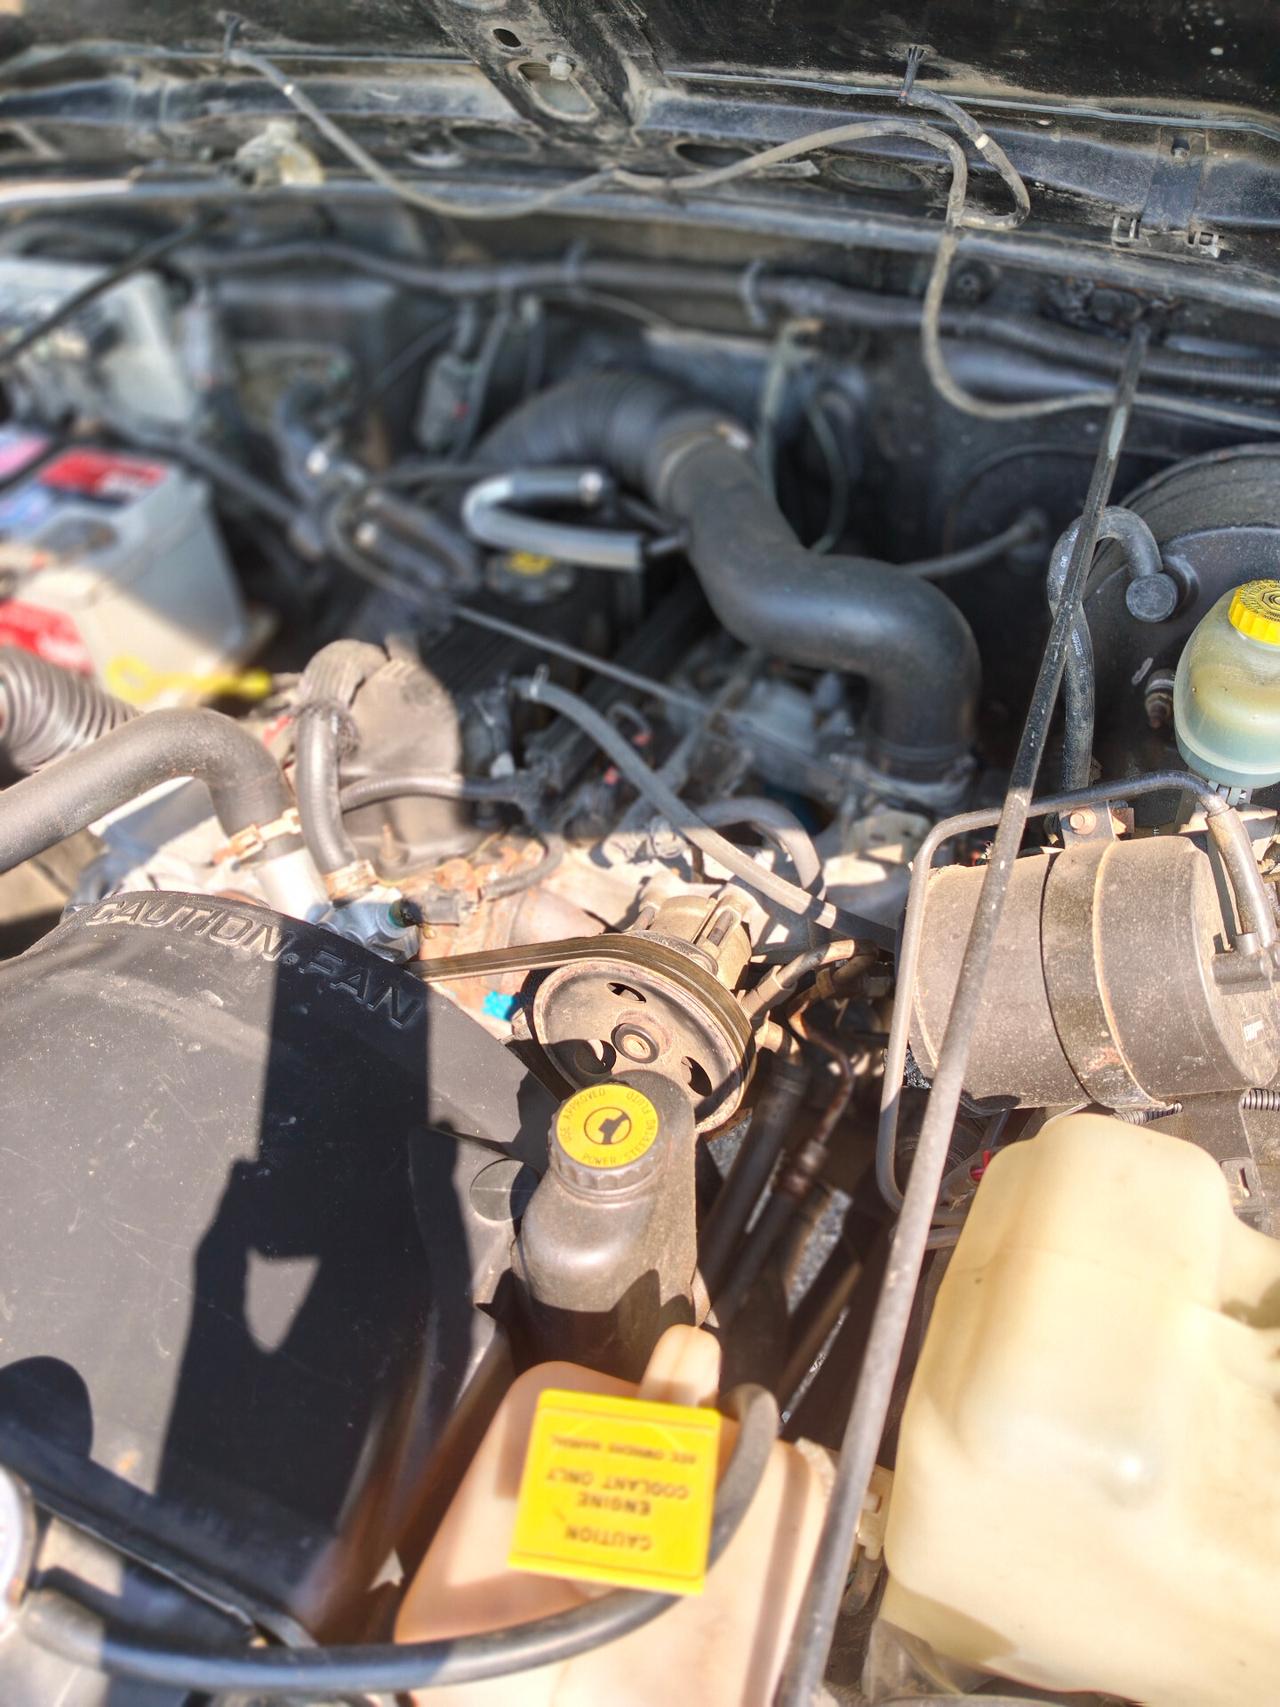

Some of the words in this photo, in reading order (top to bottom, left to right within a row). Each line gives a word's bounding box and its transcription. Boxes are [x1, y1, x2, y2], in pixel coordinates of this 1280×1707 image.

[87, 900, 293, 961] CAUTION
[299, 950, 424, 1029] FAN
[563, 1088, 605, 1119] APPROVED
[547, 1468, 593, 1487] ONLY
[603, 1476, 689, 1499] COOLANT
[577, 1492, 651, 1515] ENGINE
[565, 1525, 652, 1550] CAUTION
